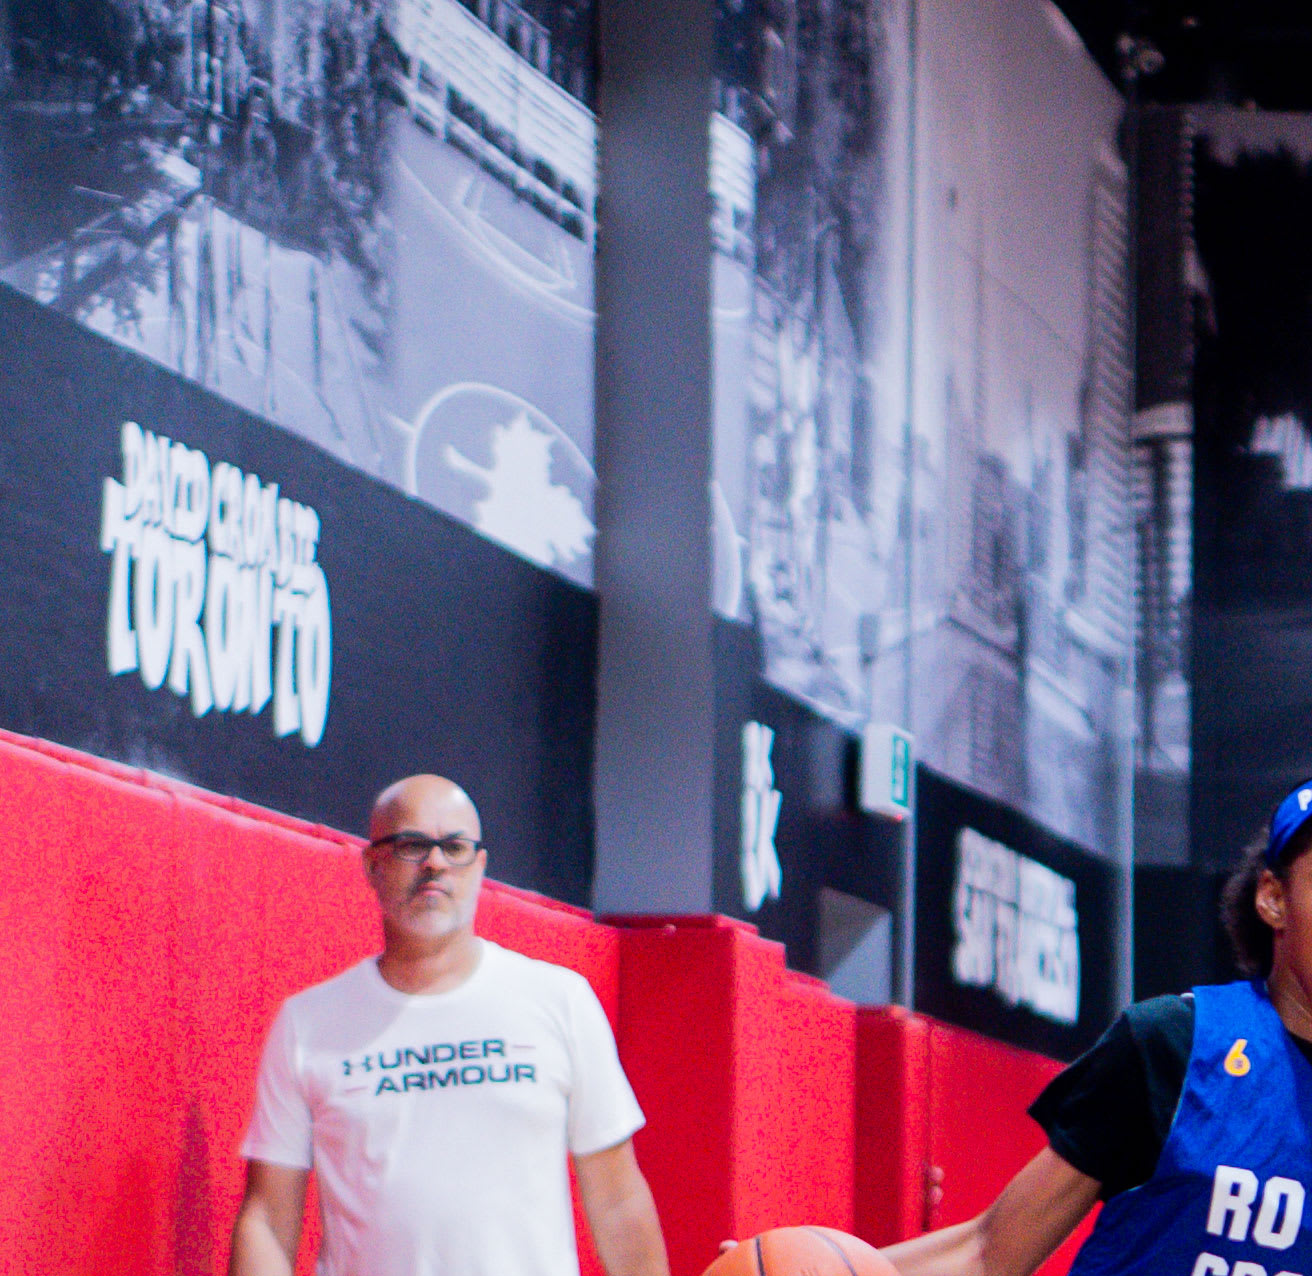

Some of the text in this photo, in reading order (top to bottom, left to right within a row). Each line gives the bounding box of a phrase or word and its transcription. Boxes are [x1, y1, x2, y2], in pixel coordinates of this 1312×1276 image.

[101, 475, 333, 748] TORONTO
[378, 1038, 507, 1071] UNDER
[1223, 1038, 1251, 1077] 6
[375, 1063, 538, 1097] ARMOUR
